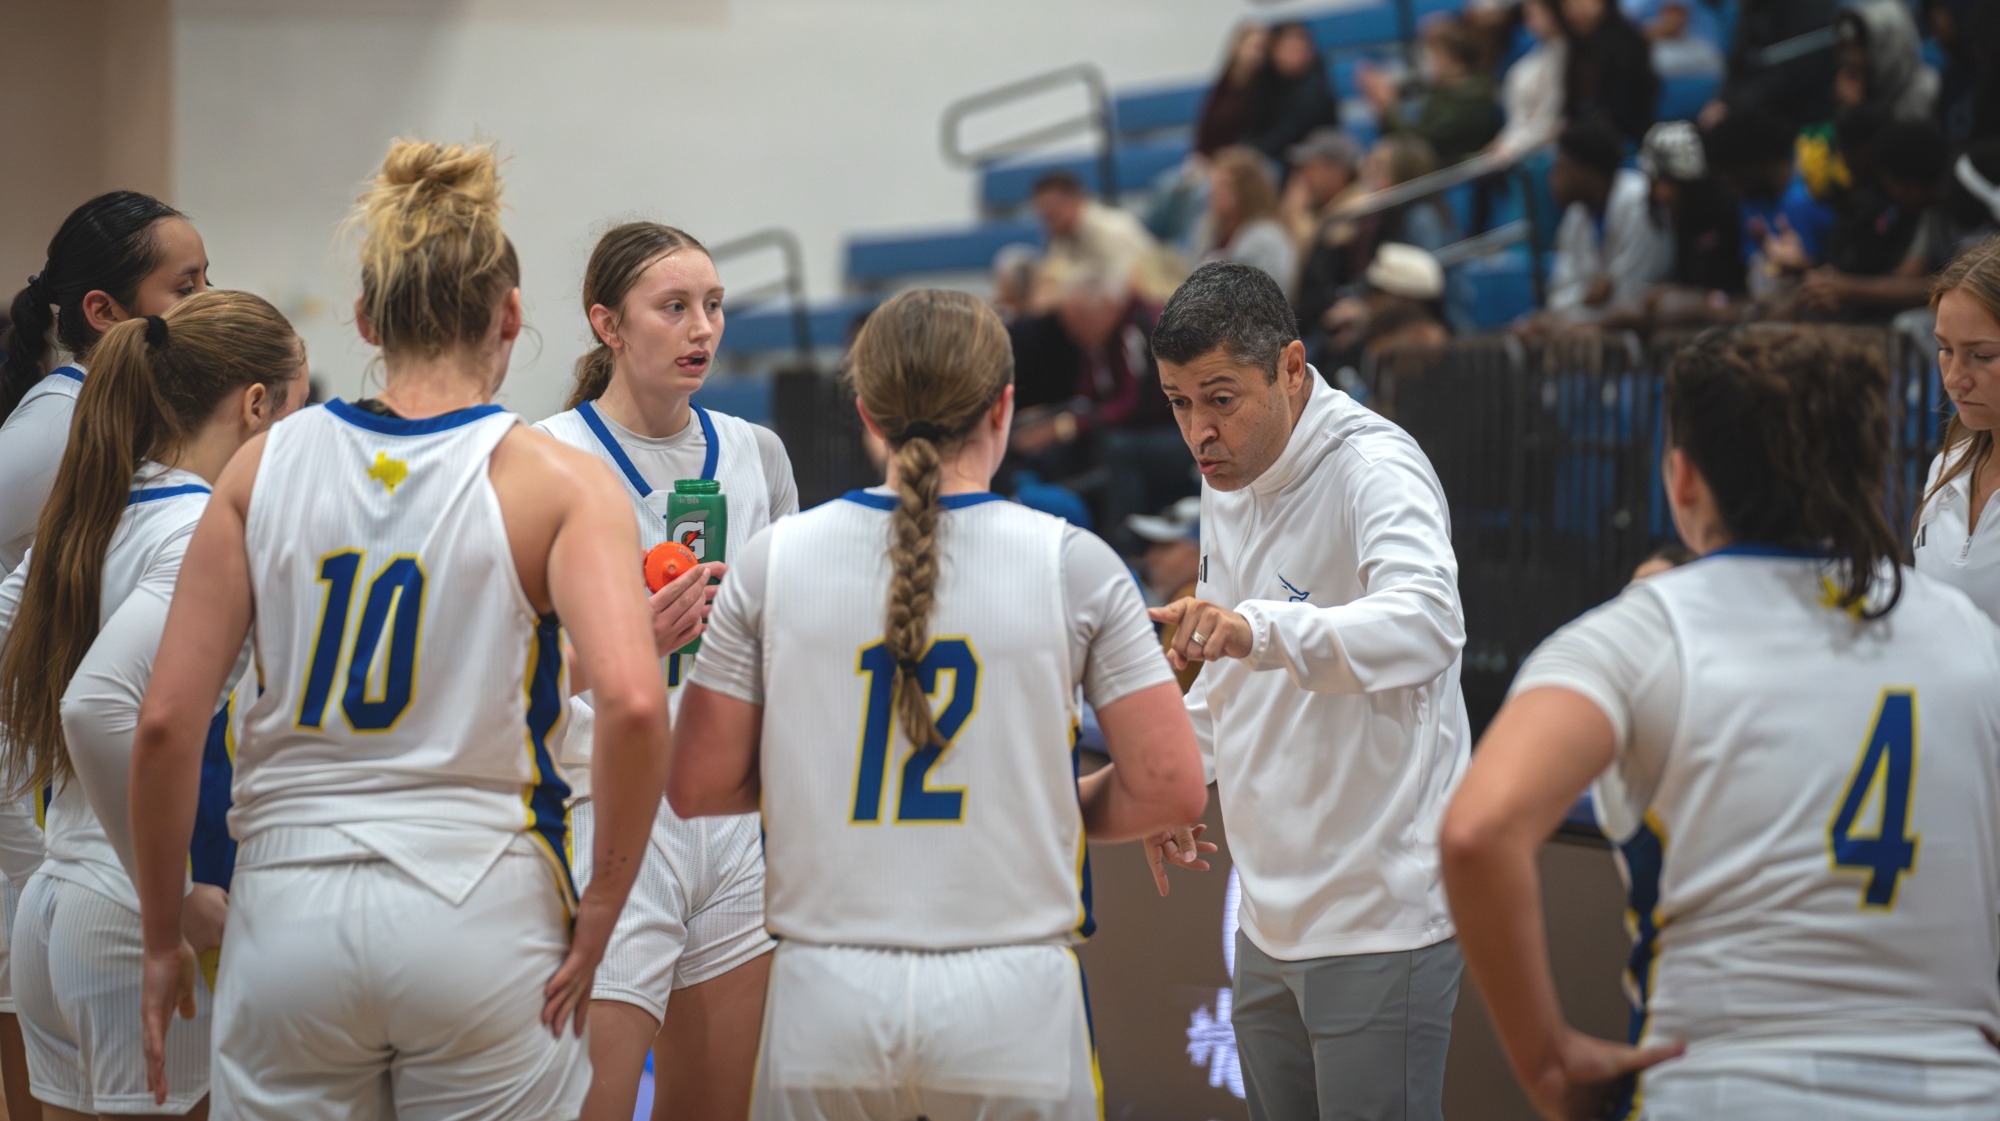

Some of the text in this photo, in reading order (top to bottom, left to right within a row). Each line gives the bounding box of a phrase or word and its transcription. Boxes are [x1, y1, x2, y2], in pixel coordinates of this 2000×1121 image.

[673, 520, 706, 561] G
[295, 548, 427, 733] 10
[849, 635, 982, 825] 12
[1827, 687, 1919, 911] 4
